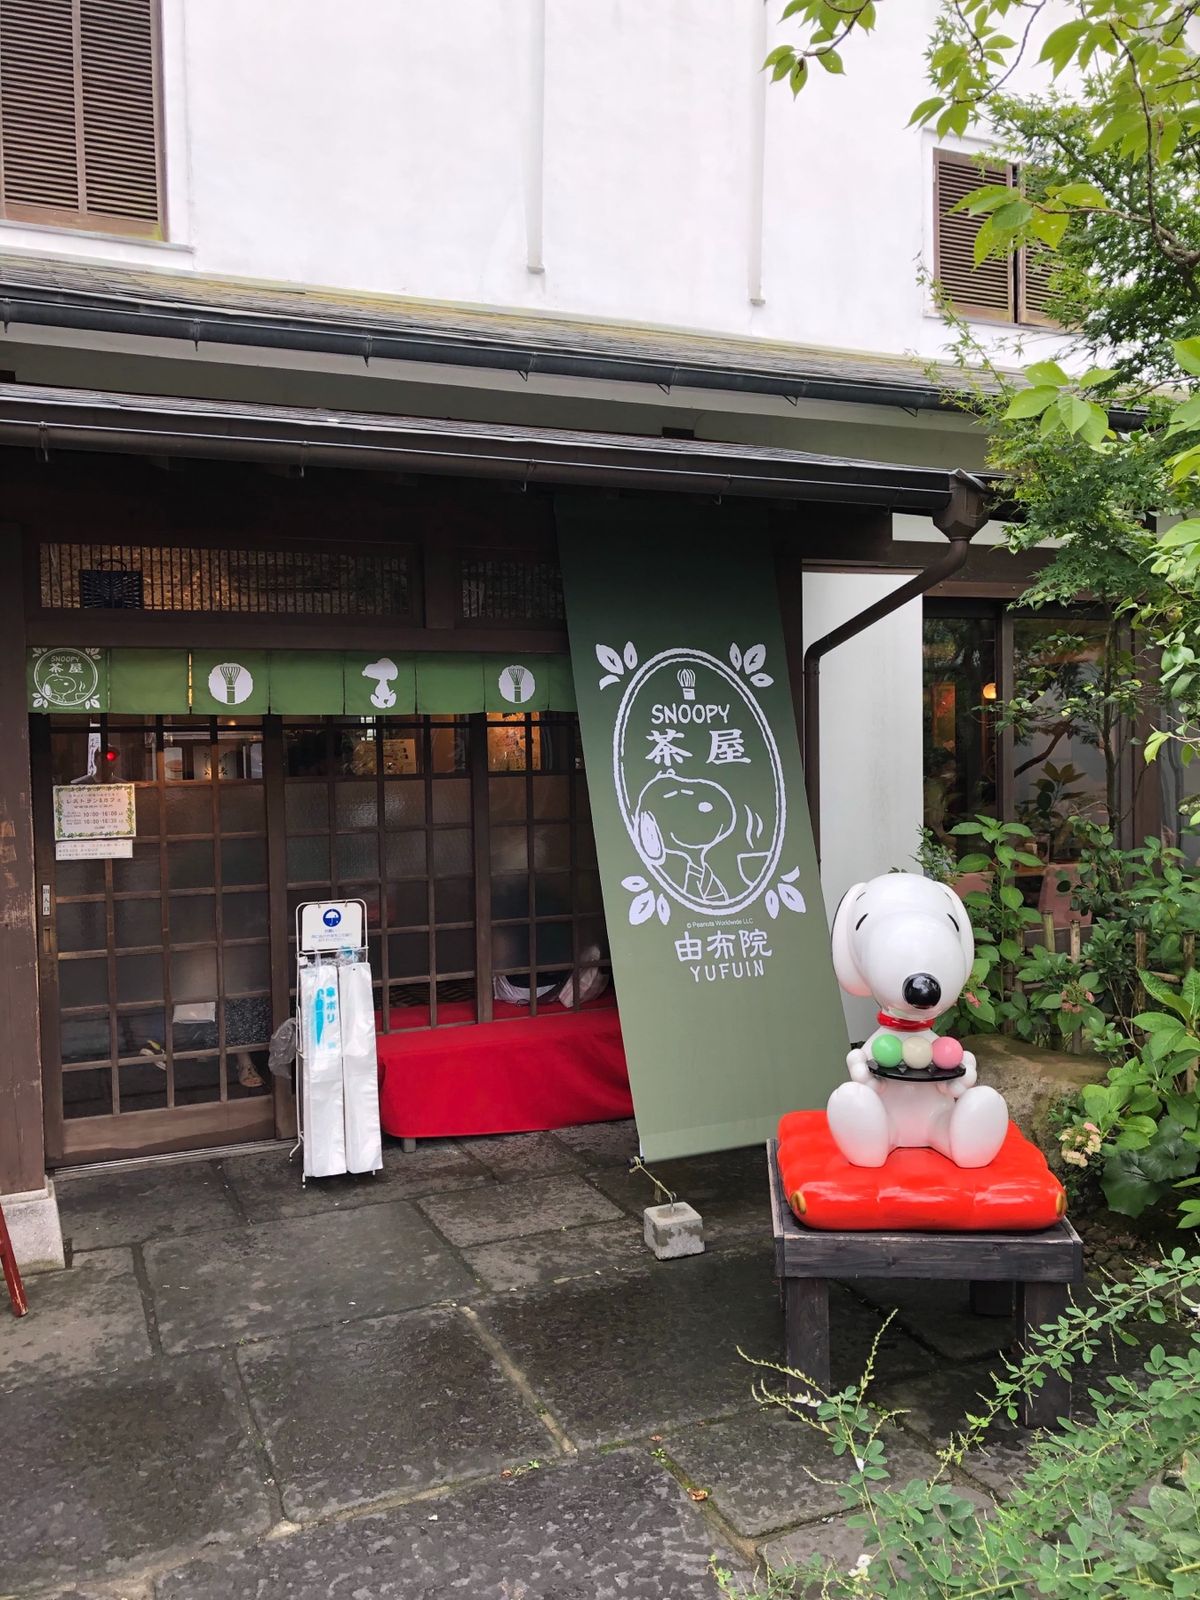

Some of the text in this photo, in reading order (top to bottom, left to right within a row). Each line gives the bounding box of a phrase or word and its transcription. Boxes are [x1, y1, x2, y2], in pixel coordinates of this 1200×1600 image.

[49, 663, 84, 673] 茶屋
[651, 703, 730, 725] SNOOPY
[645, 728, 752, 766] 茶屋
[693, 921, 715, 929] Peanuts
[742, 917, 754, 925] LLC
[674, 928, 773, 962] 由布院
[689, 959, 764, 983] YUFUIN
